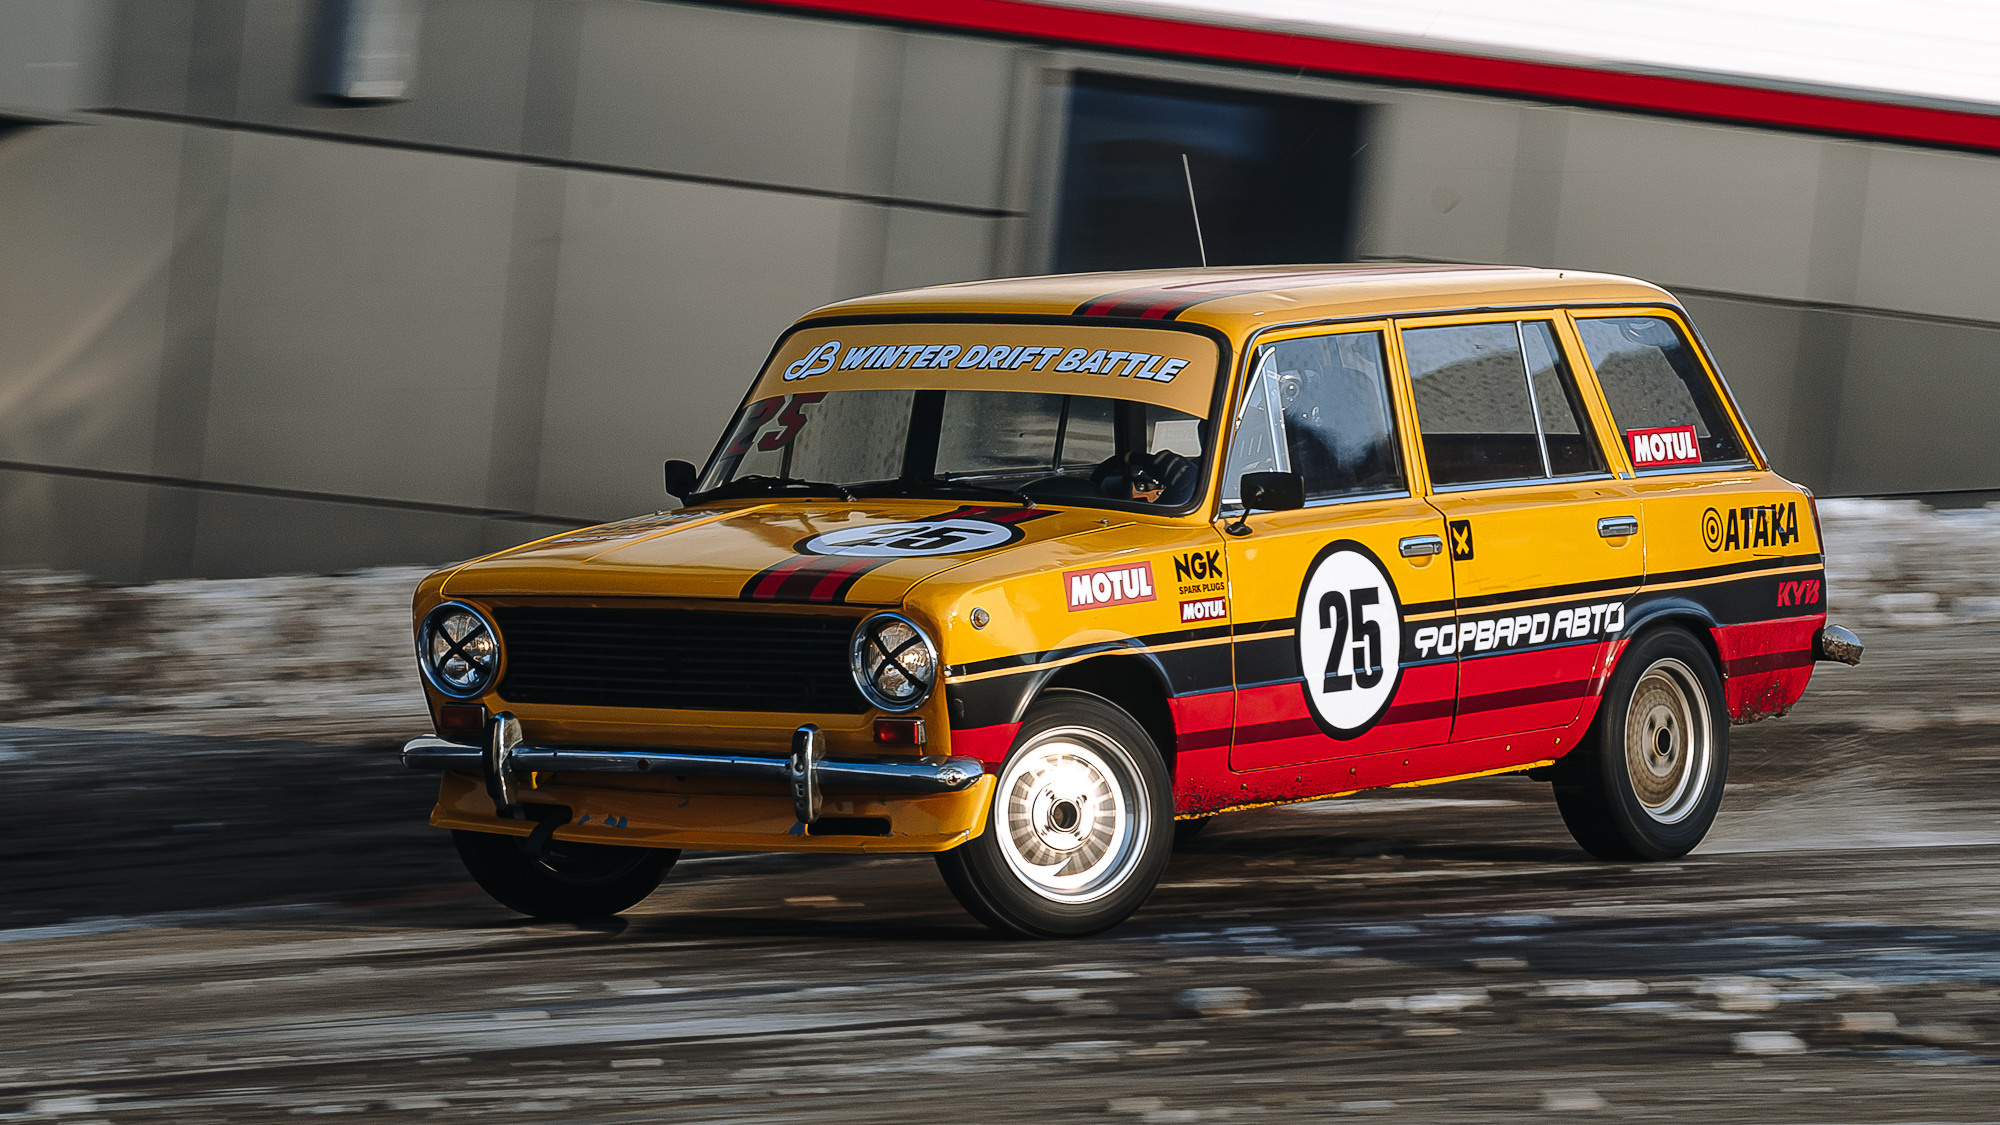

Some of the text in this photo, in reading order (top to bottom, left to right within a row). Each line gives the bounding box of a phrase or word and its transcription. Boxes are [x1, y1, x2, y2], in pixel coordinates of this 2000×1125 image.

[838, 345, 961, 371] WINTER
[955, 344, 1065, 371] DRIFT
[1053, 348, 1191, 383] BATTLE
[1633, 431, 1697, 463] MOTUL
[1173, 549, 1223, 582] NGK
[1070, 567, 1152, 606] MOTUL
[1179, 581, 1225, 595] SPARK PLUGS
[1777, 579, 1820, 607] KYB
[1182, 599, 1226, 620] MOTUL
[1319, 586, 1384, 693] 25
